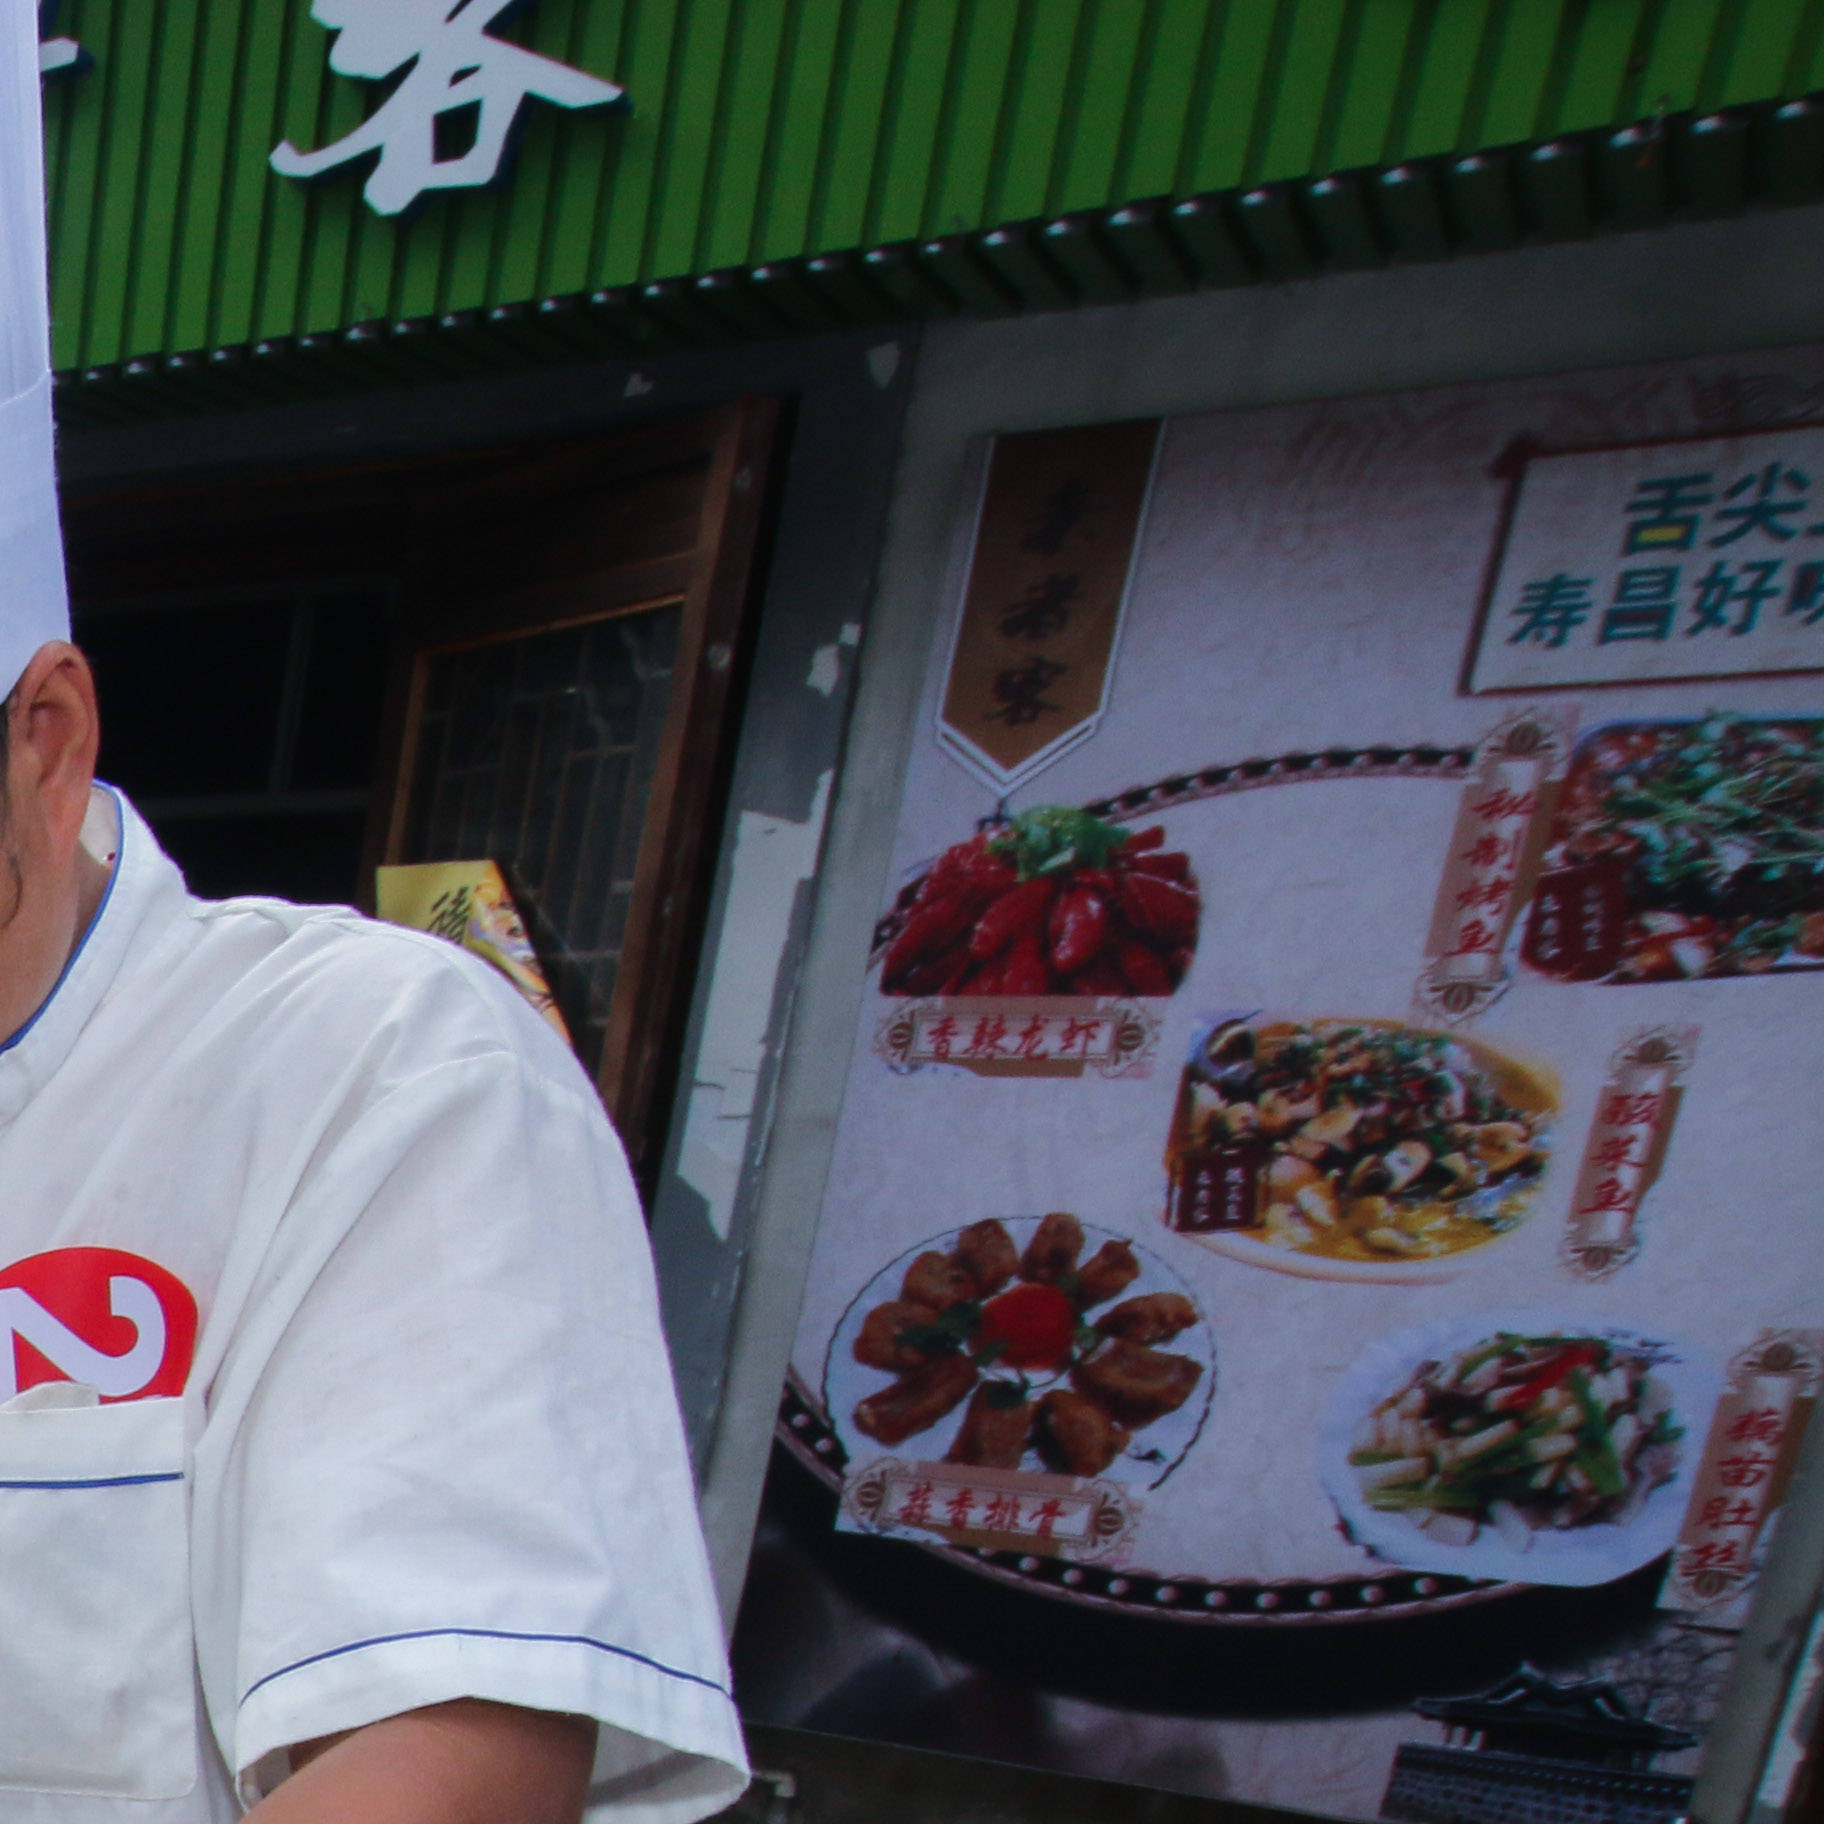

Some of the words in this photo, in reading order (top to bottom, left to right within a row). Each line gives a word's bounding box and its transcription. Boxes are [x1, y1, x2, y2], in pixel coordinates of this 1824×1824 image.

[1621, 460, 1824, 556] 舌尖
[927, 1013, 1101, 1062] 香辣龙虾
